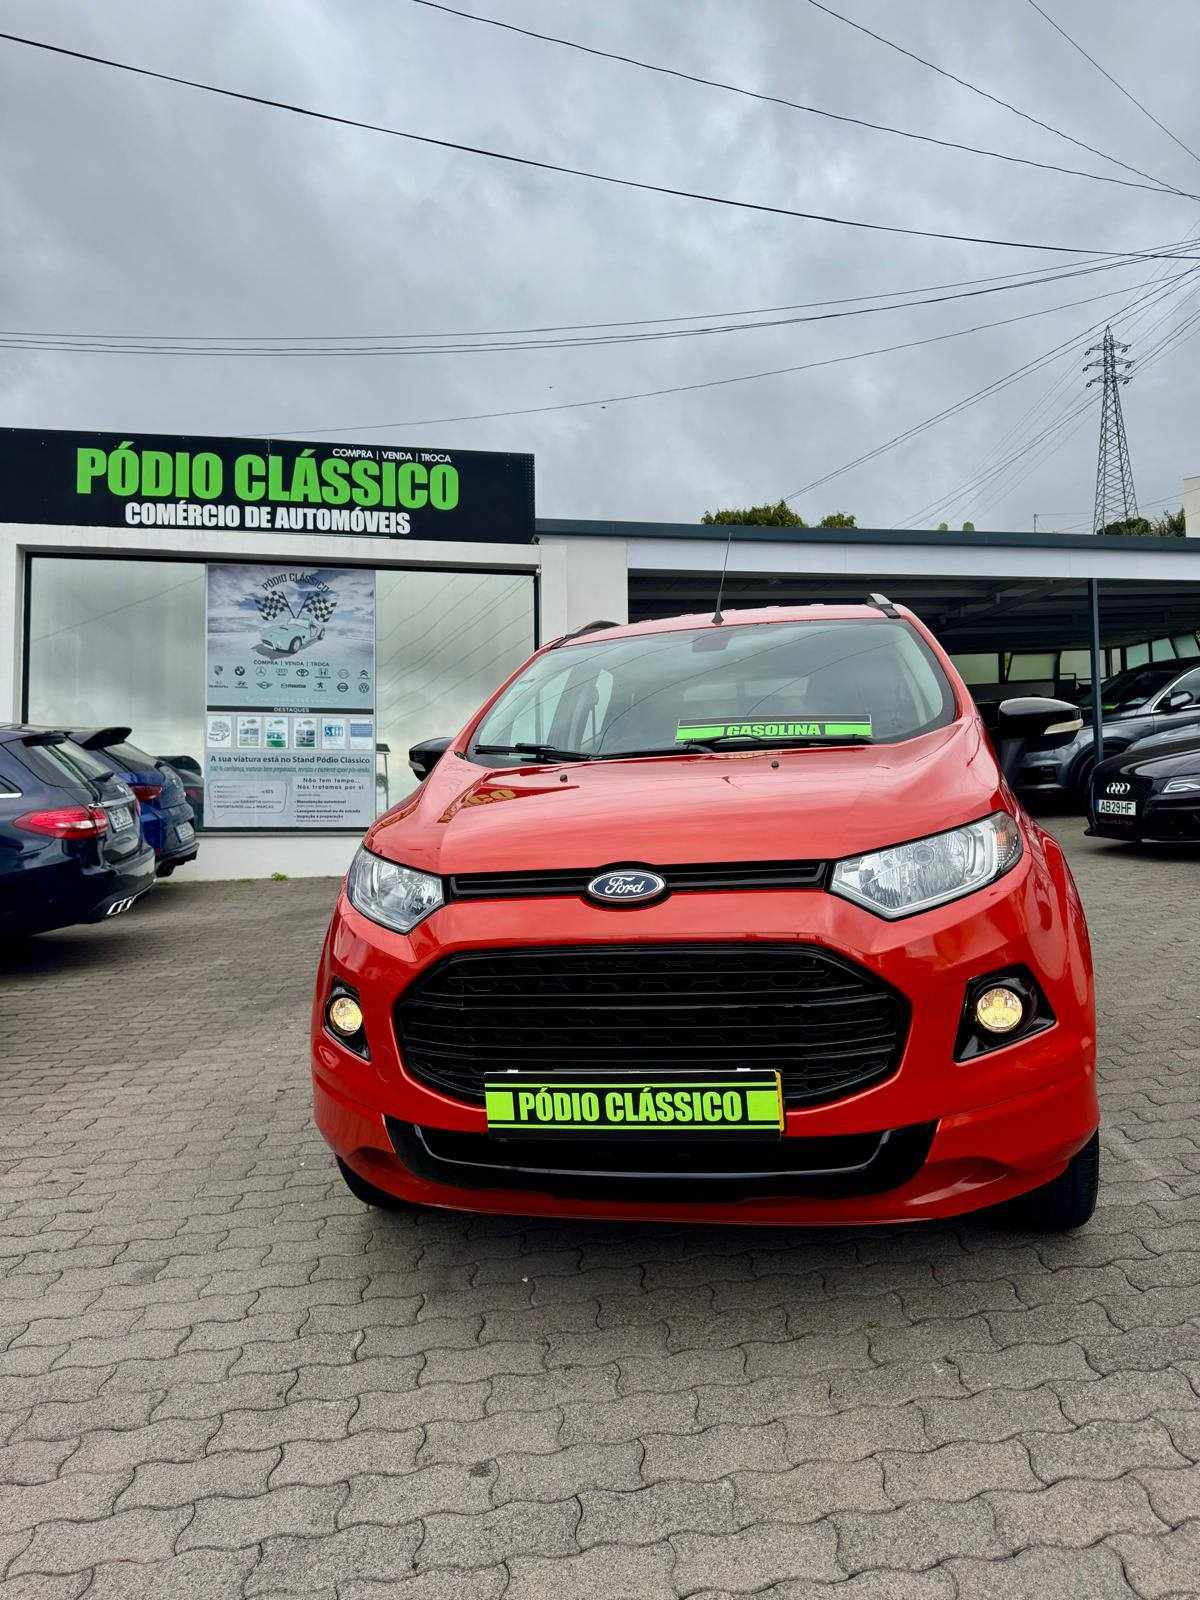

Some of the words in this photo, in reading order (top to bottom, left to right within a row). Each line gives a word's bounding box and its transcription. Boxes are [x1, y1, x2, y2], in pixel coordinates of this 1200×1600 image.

[332, 448, 373, 459] COMPRA
[382, 451, 412, 461] VENDA
[421, 453, 451, 463] TROCA
[77, 441, 222, 499] PÓDIO
[235, 449, 459, 510] CLÁSSICO
[125, 500, 240, 527] COMÉRCIO
[245, 505, 271, 528] DE
[275, 506, 411, 534] AUTOMÓVEIS
[727, 724, 821, 736] GASOLINA
[604, 876, 646, 894] Ford
[518, 1087, 600, 1122] PÓDIO
[605, 1086, 742, 1122] CLÁSSICO
